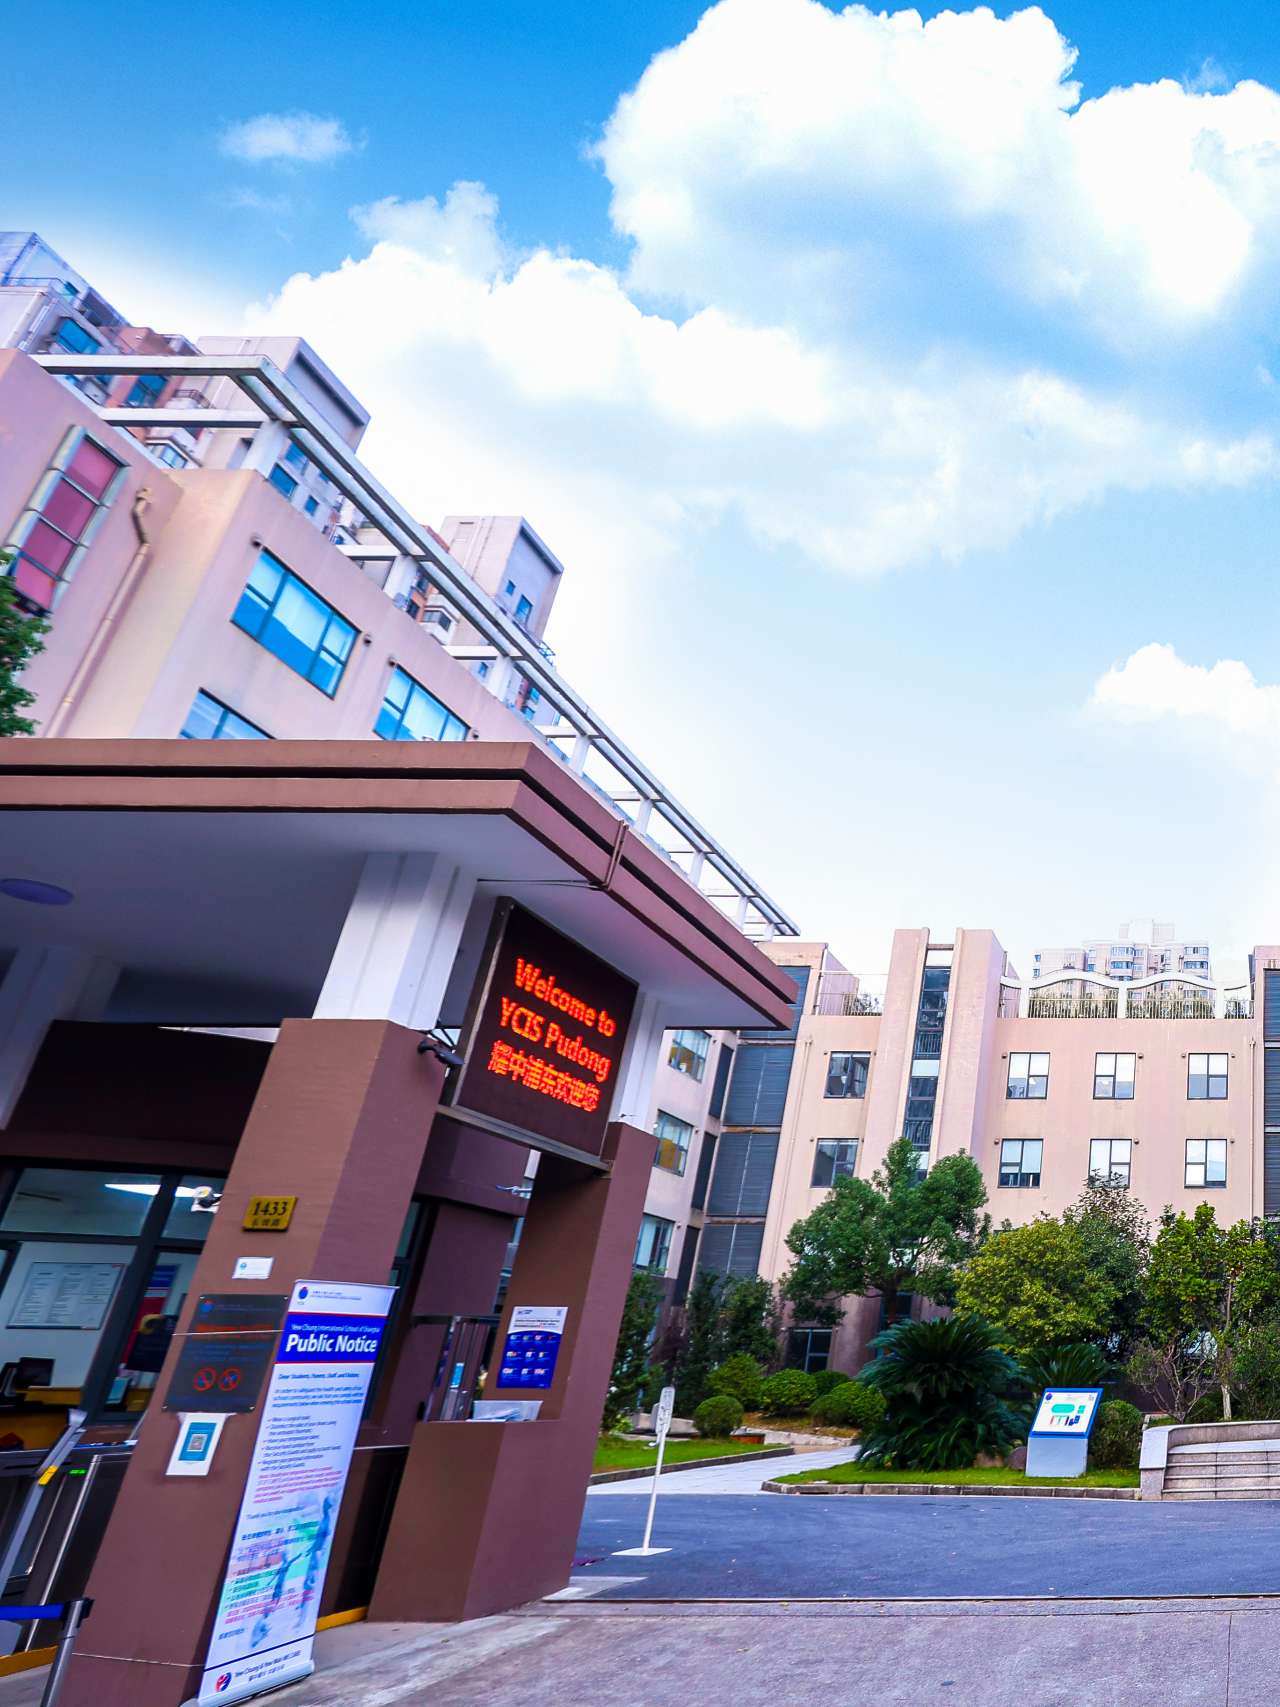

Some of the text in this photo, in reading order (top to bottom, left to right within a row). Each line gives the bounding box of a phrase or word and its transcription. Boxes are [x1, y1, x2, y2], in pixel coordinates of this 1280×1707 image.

[515, 958, 617, 1037] Welcome to
[500, 997, 612, 1082] YCIS Pudong
[254, 1201, 288, 1216] 1433
[285, 1333, 335, 1352] Public
[335, 1334, 378, 1352] Notice
